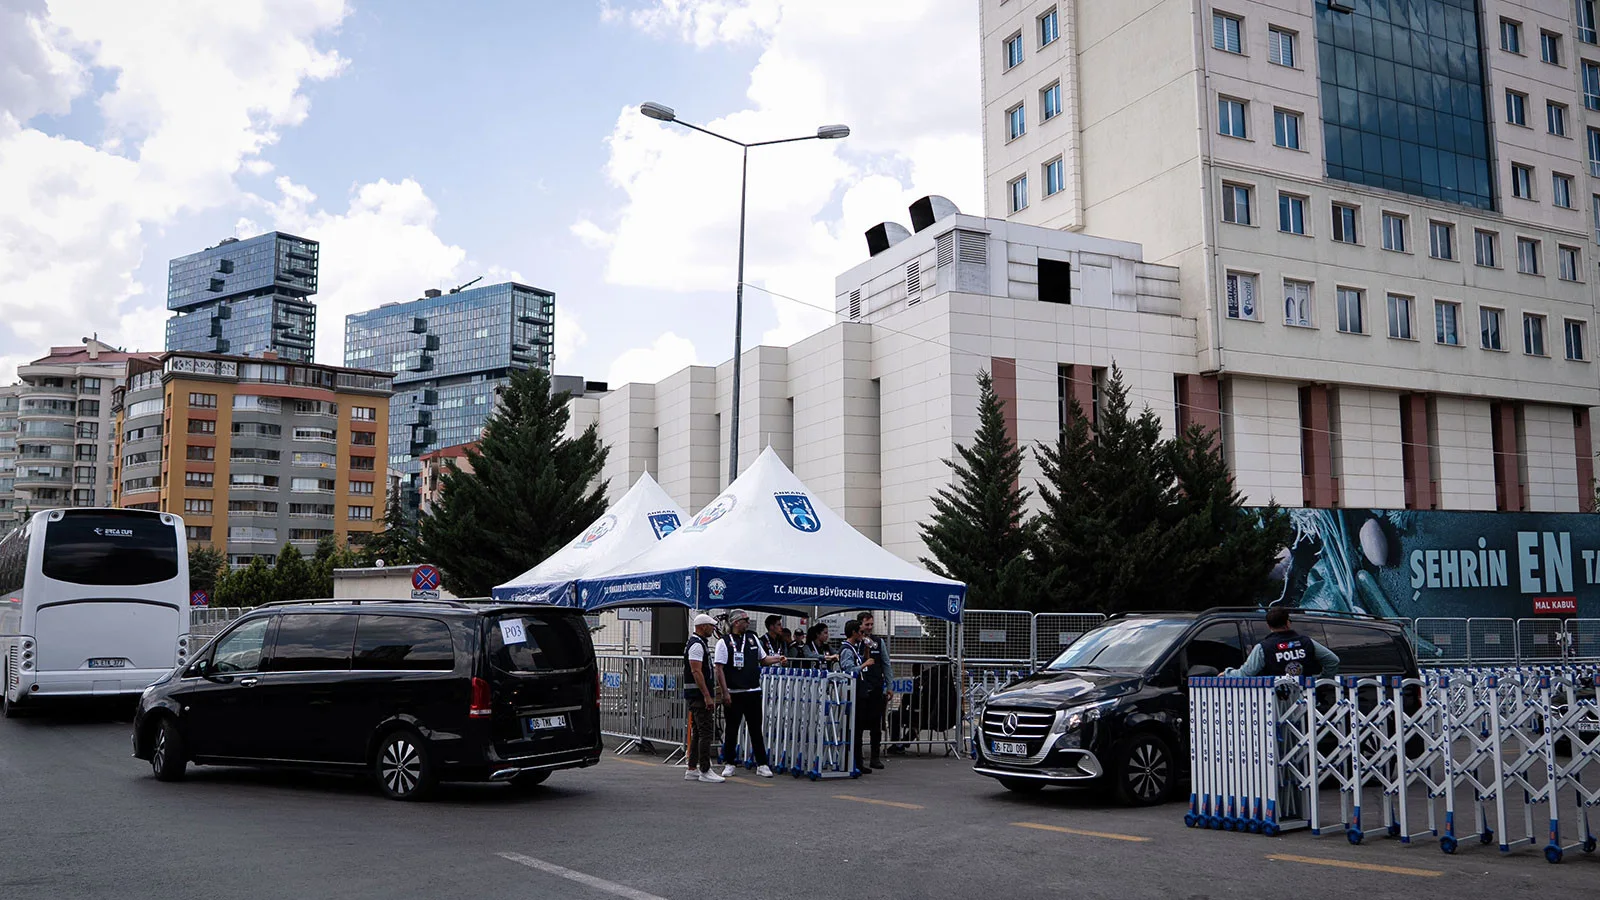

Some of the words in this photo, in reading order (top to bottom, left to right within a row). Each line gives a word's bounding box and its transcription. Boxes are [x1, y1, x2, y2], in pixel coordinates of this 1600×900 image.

[1410, 536, 1508, 601] ŞEHRİN
[1517, 531, 1574, 594] EN
[773, 585, 786, 594] T.C.
[787, 586, 818, 596] ANKARA
[820, 586, 864, 599] BÜYÜKŞEHİR
[865, 590, 903, 601] BELEDİYESİ
[1535, 601, 1550, 609] MAL
[1552, 600, 1575, 609] KABUL
[504, 625, 522, 638] P03
